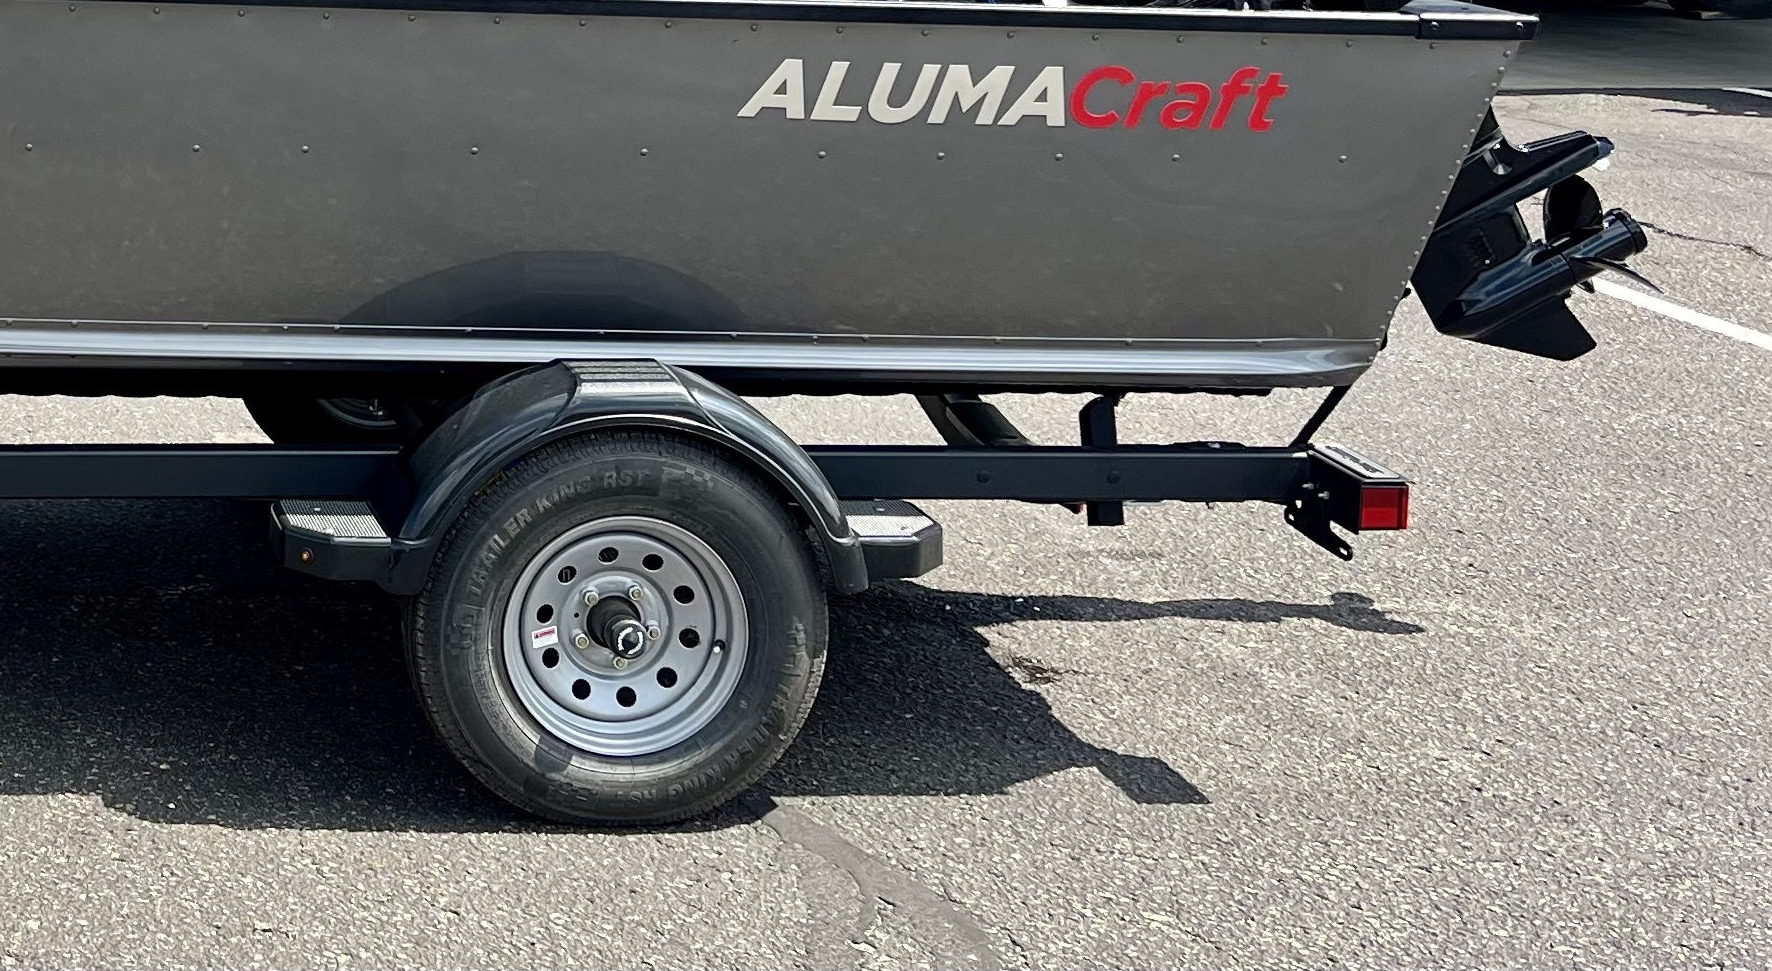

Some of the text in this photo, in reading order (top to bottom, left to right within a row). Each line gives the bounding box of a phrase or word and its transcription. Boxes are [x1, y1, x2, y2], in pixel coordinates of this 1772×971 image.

[736, 58, 1289, 133] ALUMACraft
[535, 476, 592, 514] KING
[603, 468, 652, 488] RST
